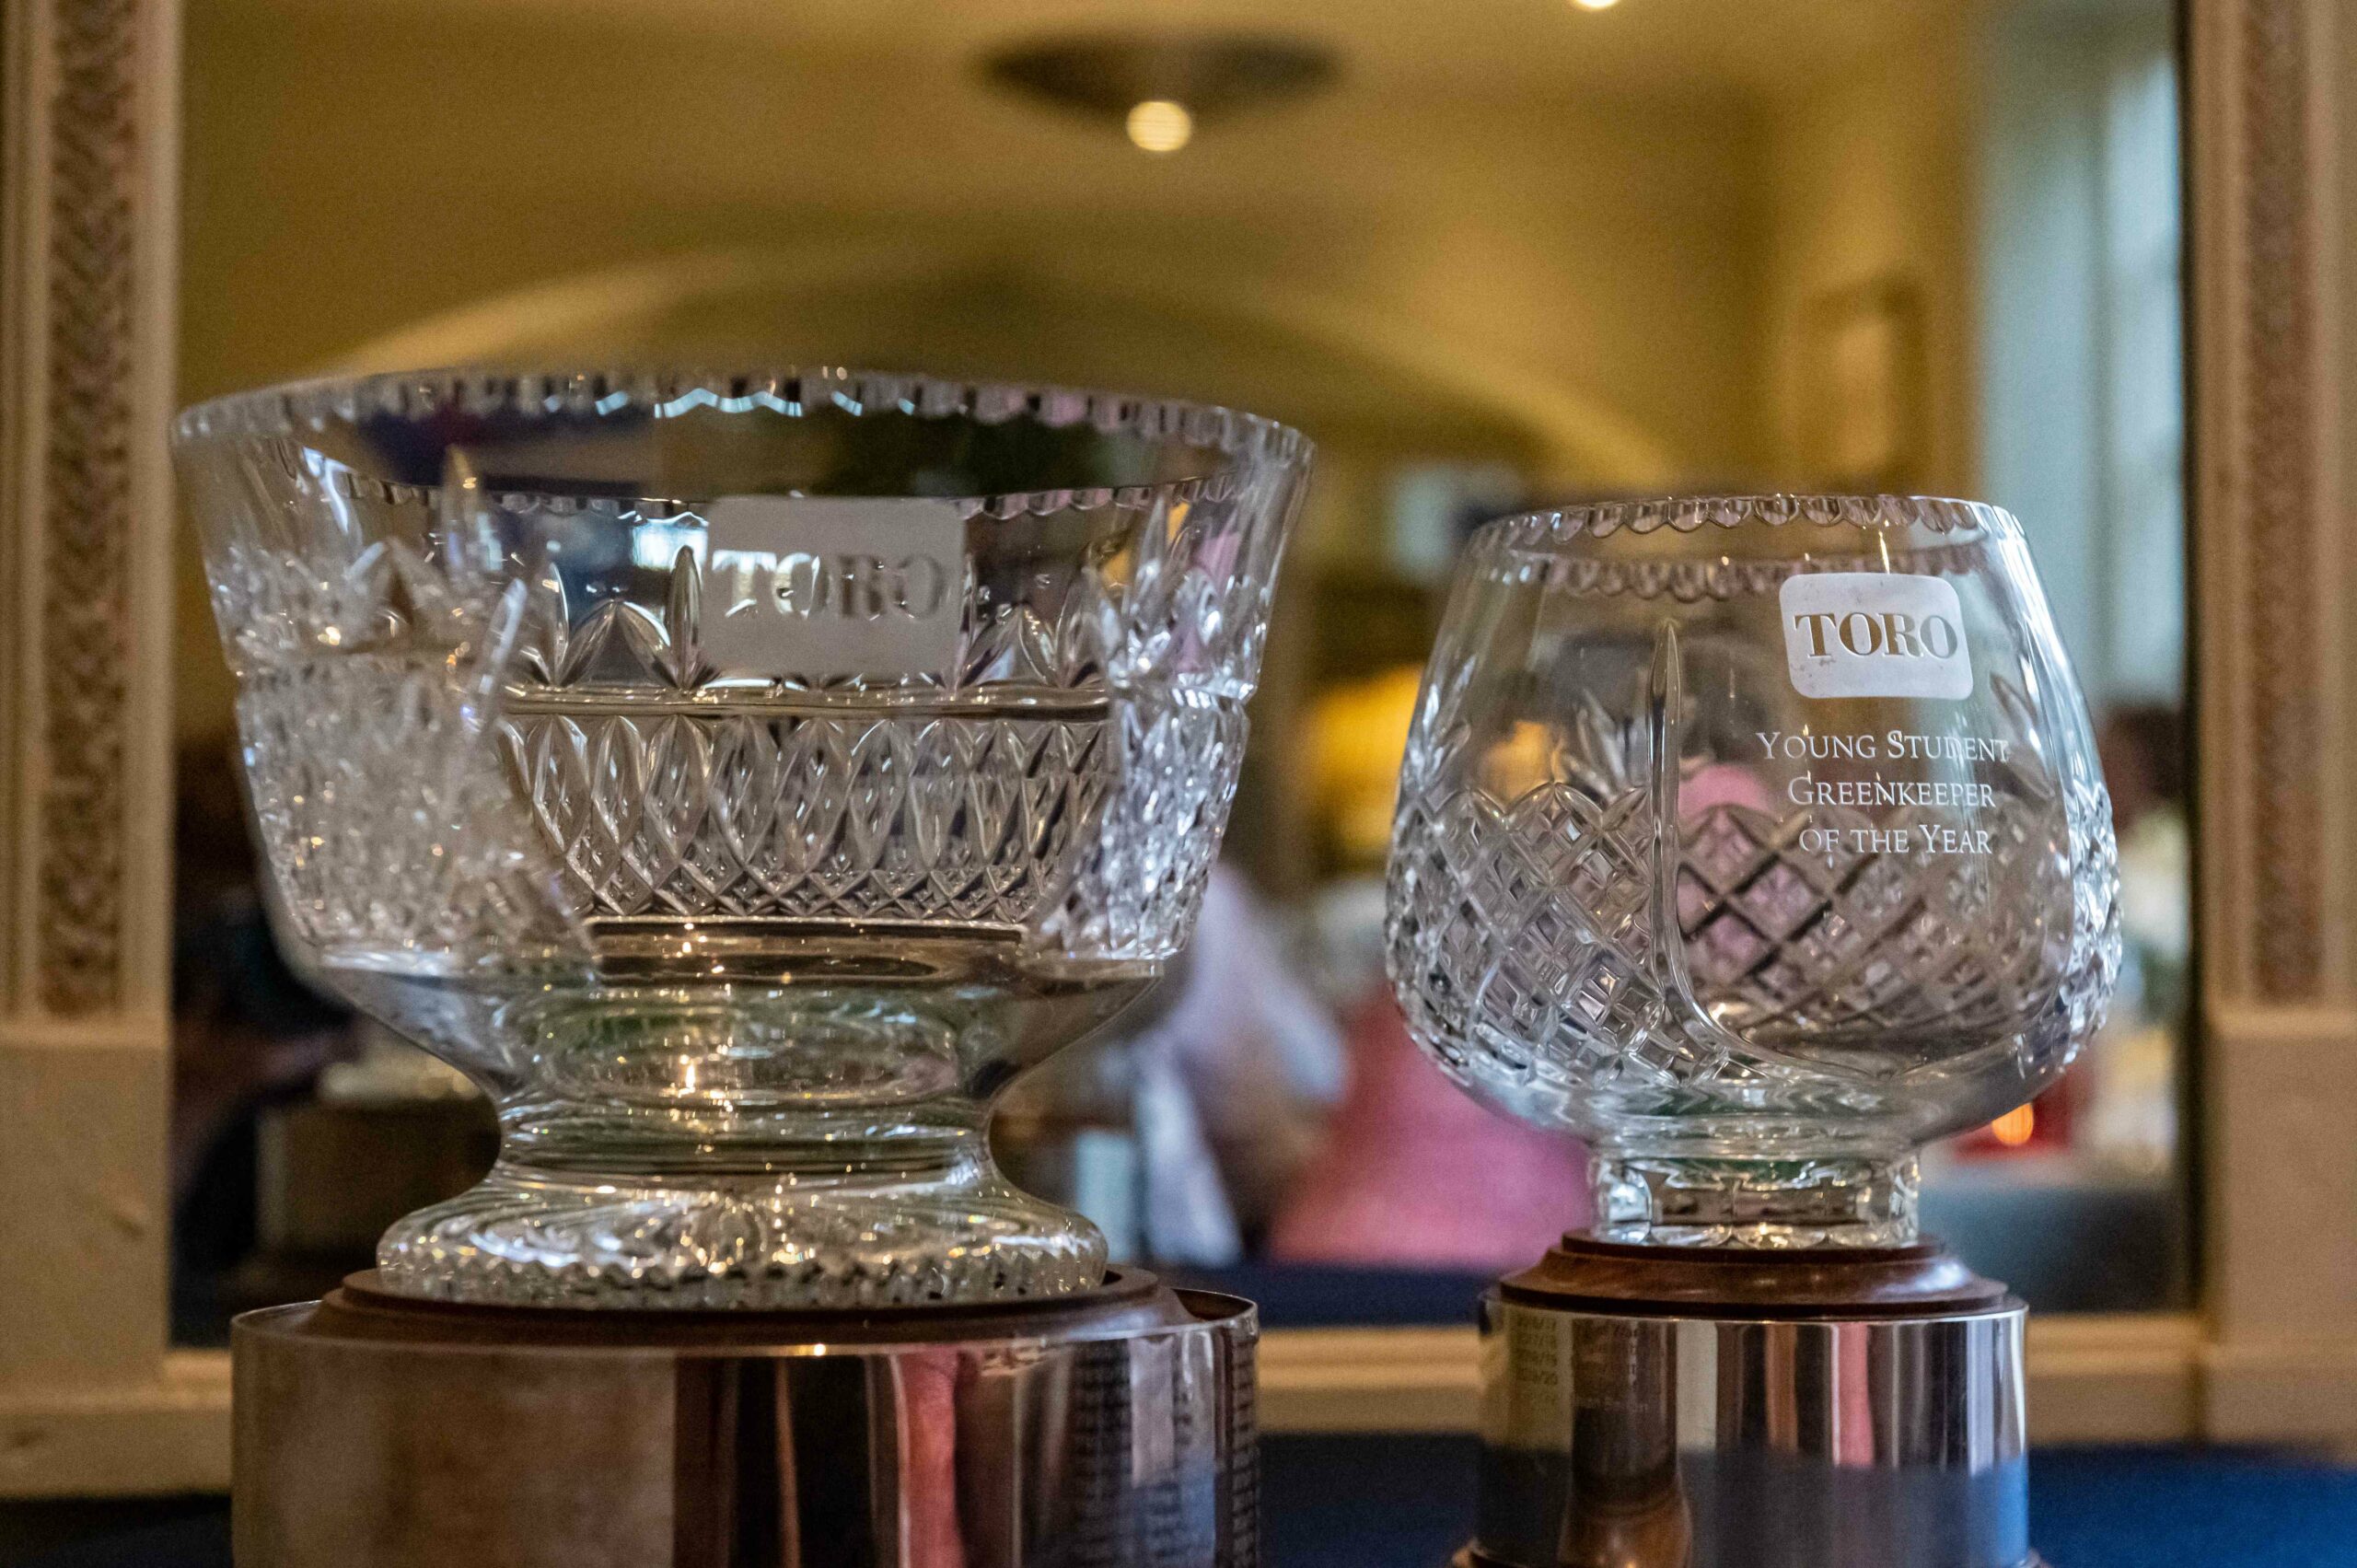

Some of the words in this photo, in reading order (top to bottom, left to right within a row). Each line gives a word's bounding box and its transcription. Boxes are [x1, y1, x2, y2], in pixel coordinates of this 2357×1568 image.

[712, 550, 946, 620] TORO
[1794, 612, 1958, 659] TORO
[1756, 732, 1876, 760] YOUNG
[1887, 730, 2010, 762] STUDENT
[1787, 777, 1996, 807] GREENKEEPER
[1798, 830, 1840, 853] OF
[1850, 830, 1910, 854] THE
[1919, 824, 1992, 854] YEAR
